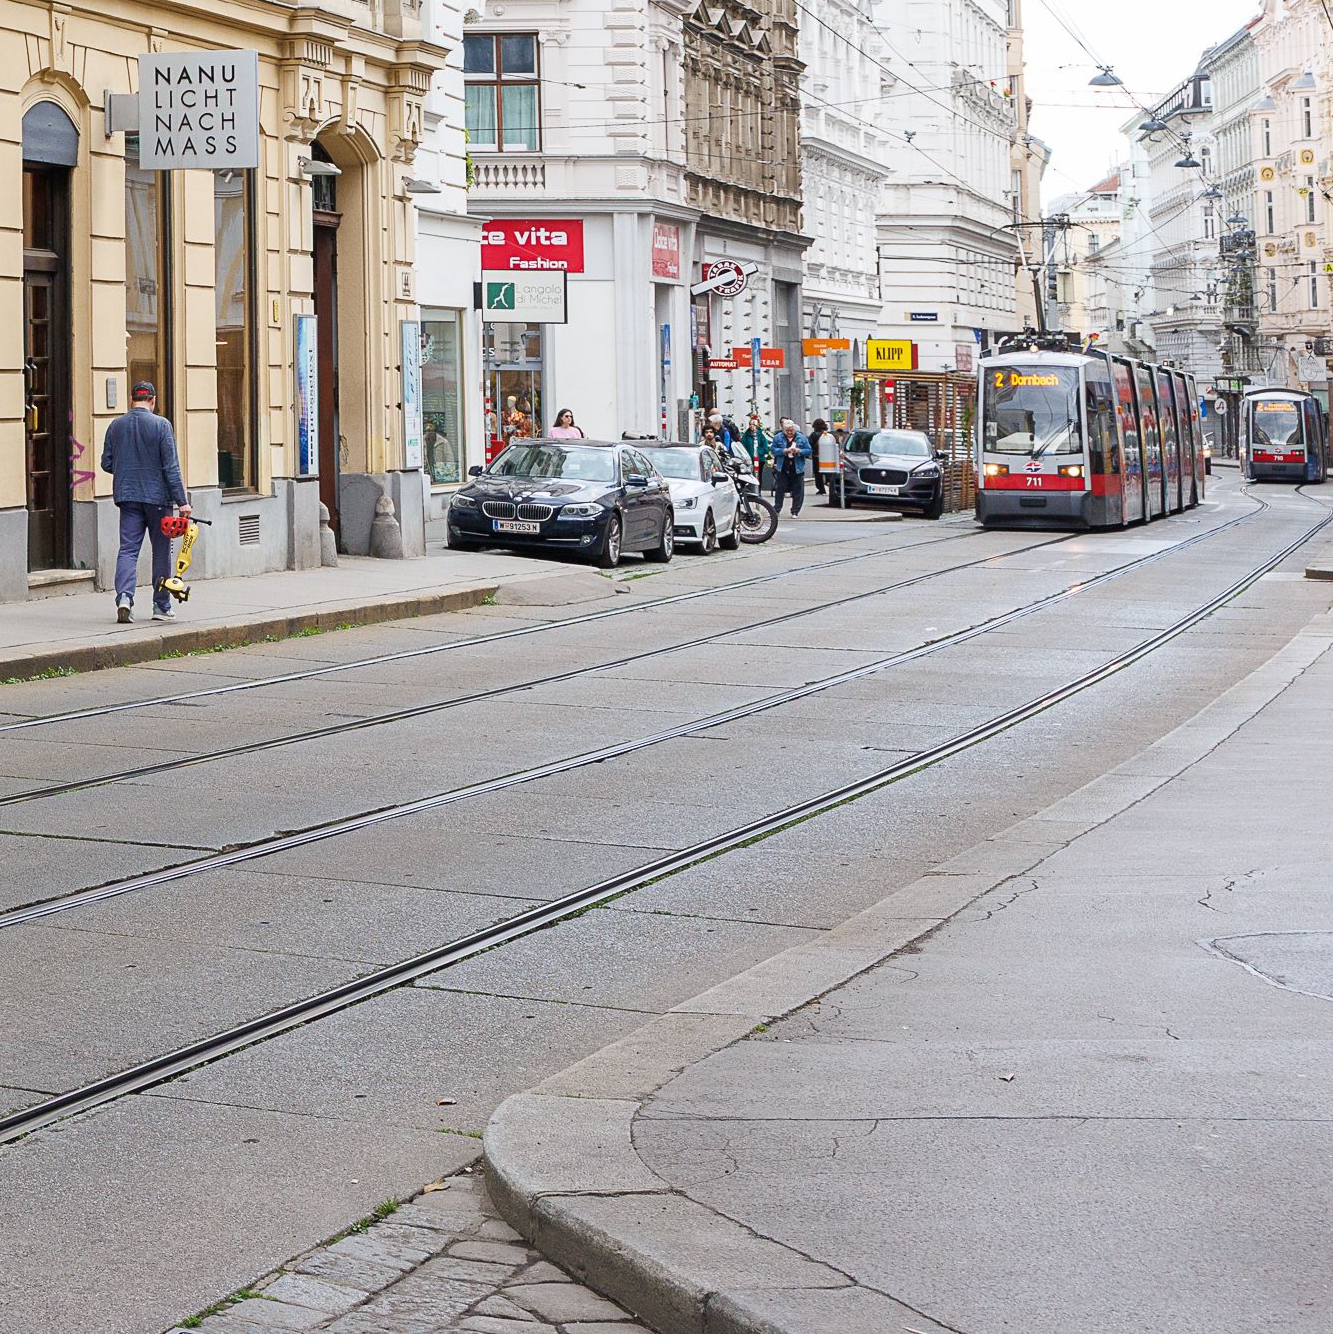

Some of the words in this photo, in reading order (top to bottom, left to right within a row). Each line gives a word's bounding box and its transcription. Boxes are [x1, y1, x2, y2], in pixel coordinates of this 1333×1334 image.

[155, 64, 235, 85] NANU
[155, 88, 237, 108] LICHT
[155, 112, 235, 132] NACH
[154, 135, 237, 156] MASS
[514, 226, 568, 245] vita
[509, 257, 568, 269] Fashion
[709, 259, 738, 278] TABAK
[717, 274, 745, 294] TRAFIK
[876, 347, 903, 360] KLIPP
[710, 360, 737, 368] AUTOMAT
[995, 372, 1004, 387] 2
[1010, 373, 1059, 386] Dornbach
[1026, 477, 1042, 486] 711
